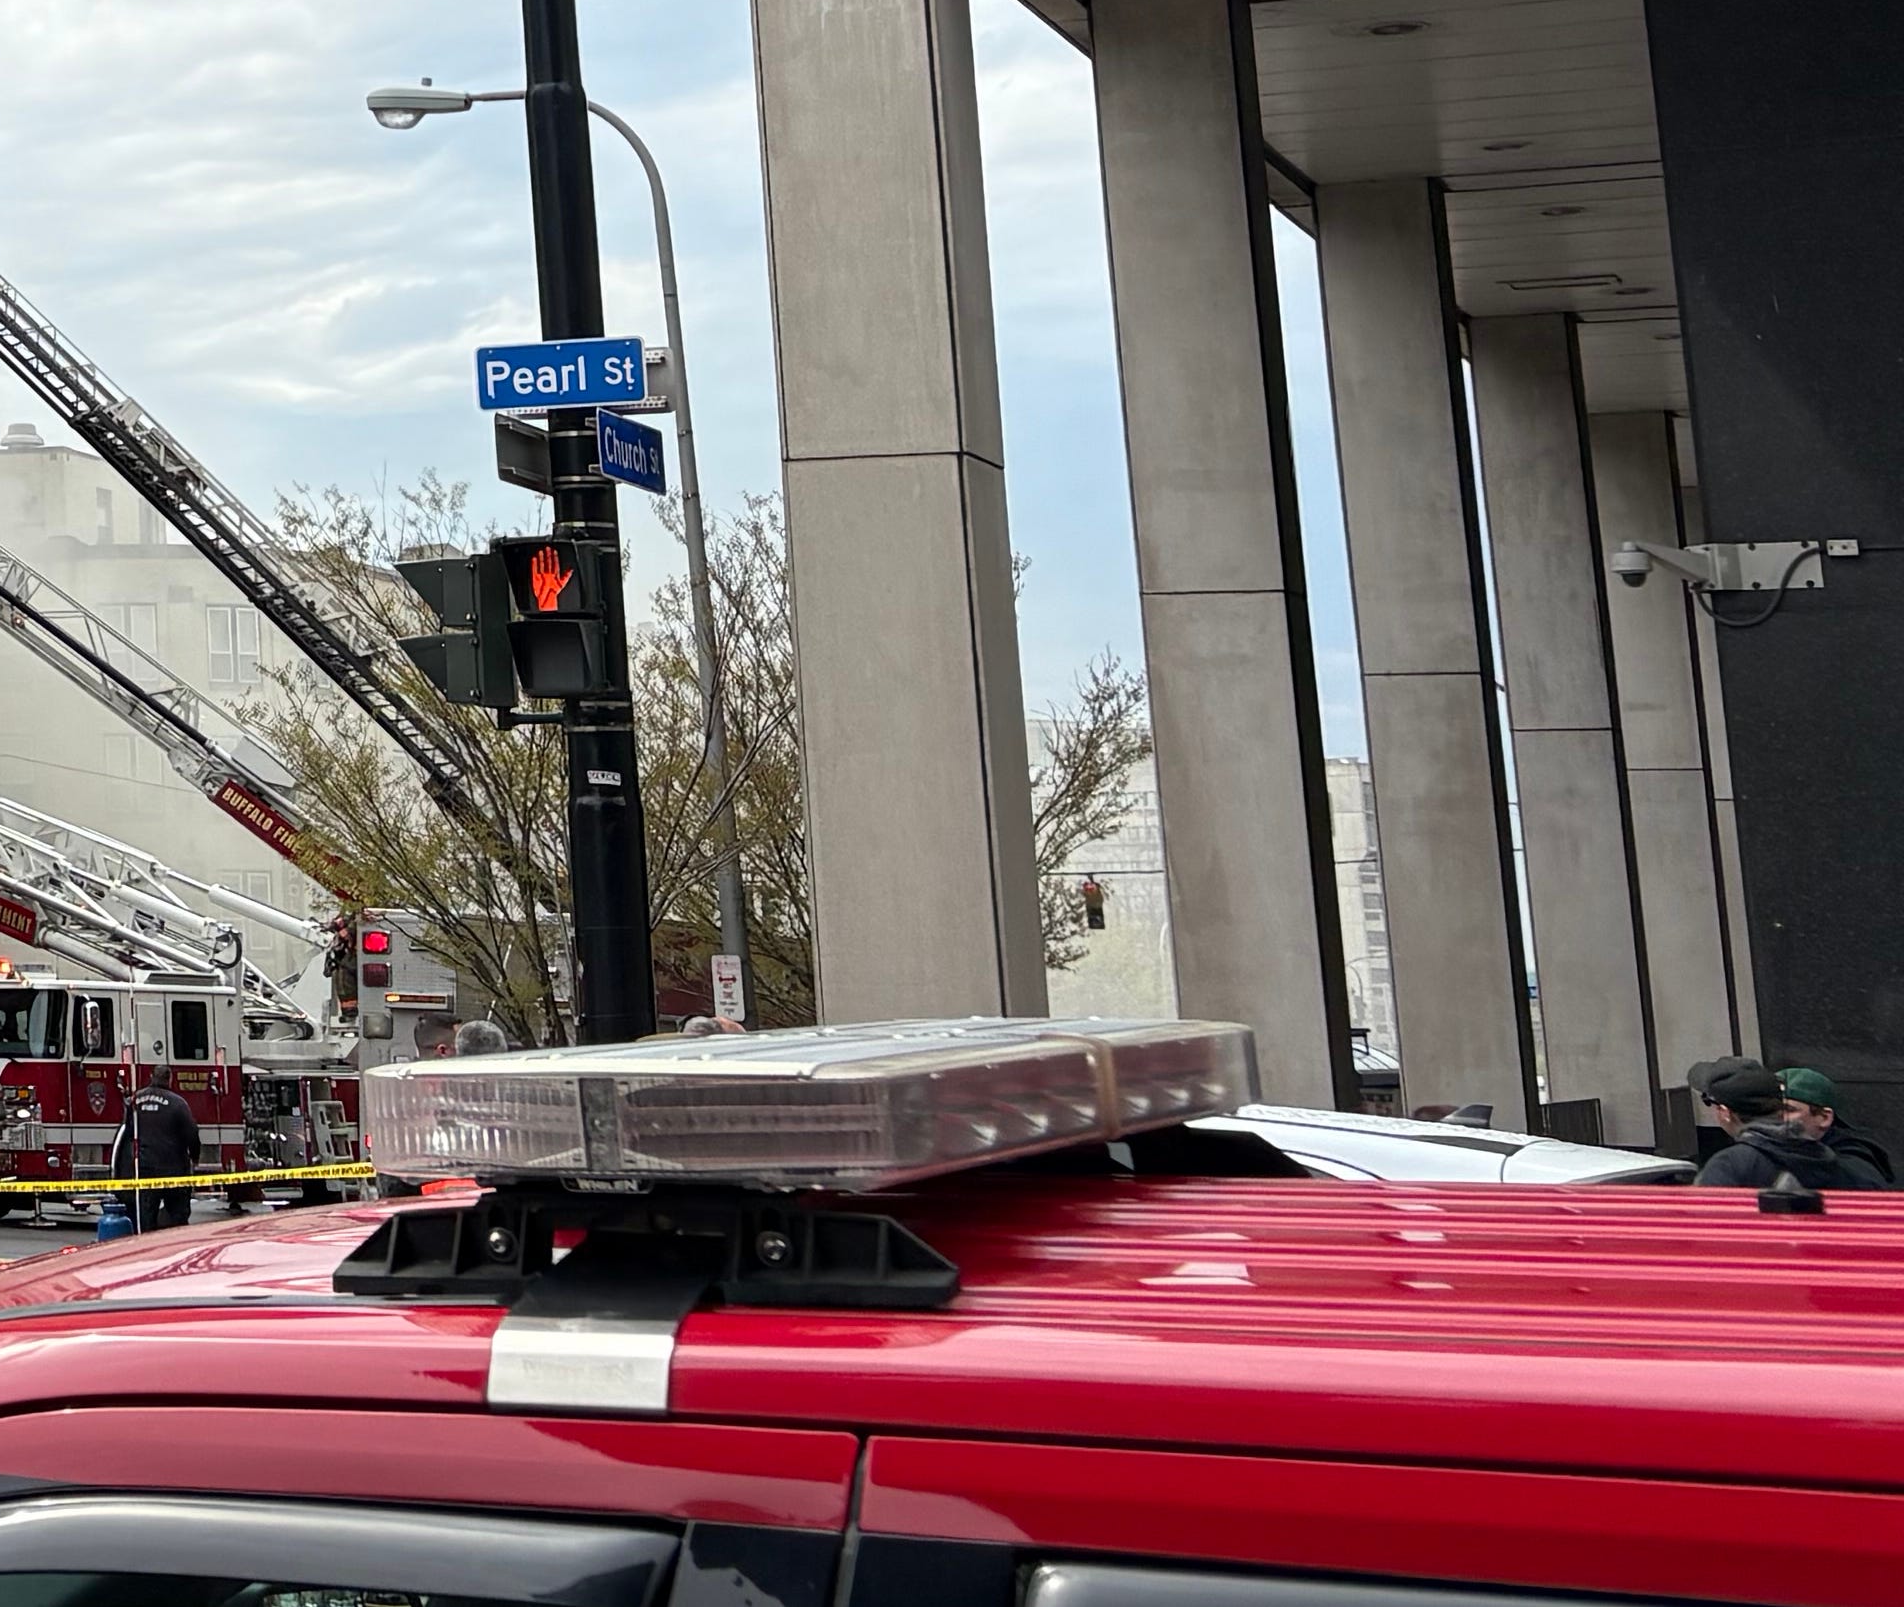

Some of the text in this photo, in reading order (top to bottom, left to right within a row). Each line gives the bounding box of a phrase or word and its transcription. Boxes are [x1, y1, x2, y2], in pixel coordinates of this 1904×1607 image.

[486, 355, 635, 395] Pearl St
[604, 426, 648, 475] Church
[222, 787, 274, 831] BUFFALO
